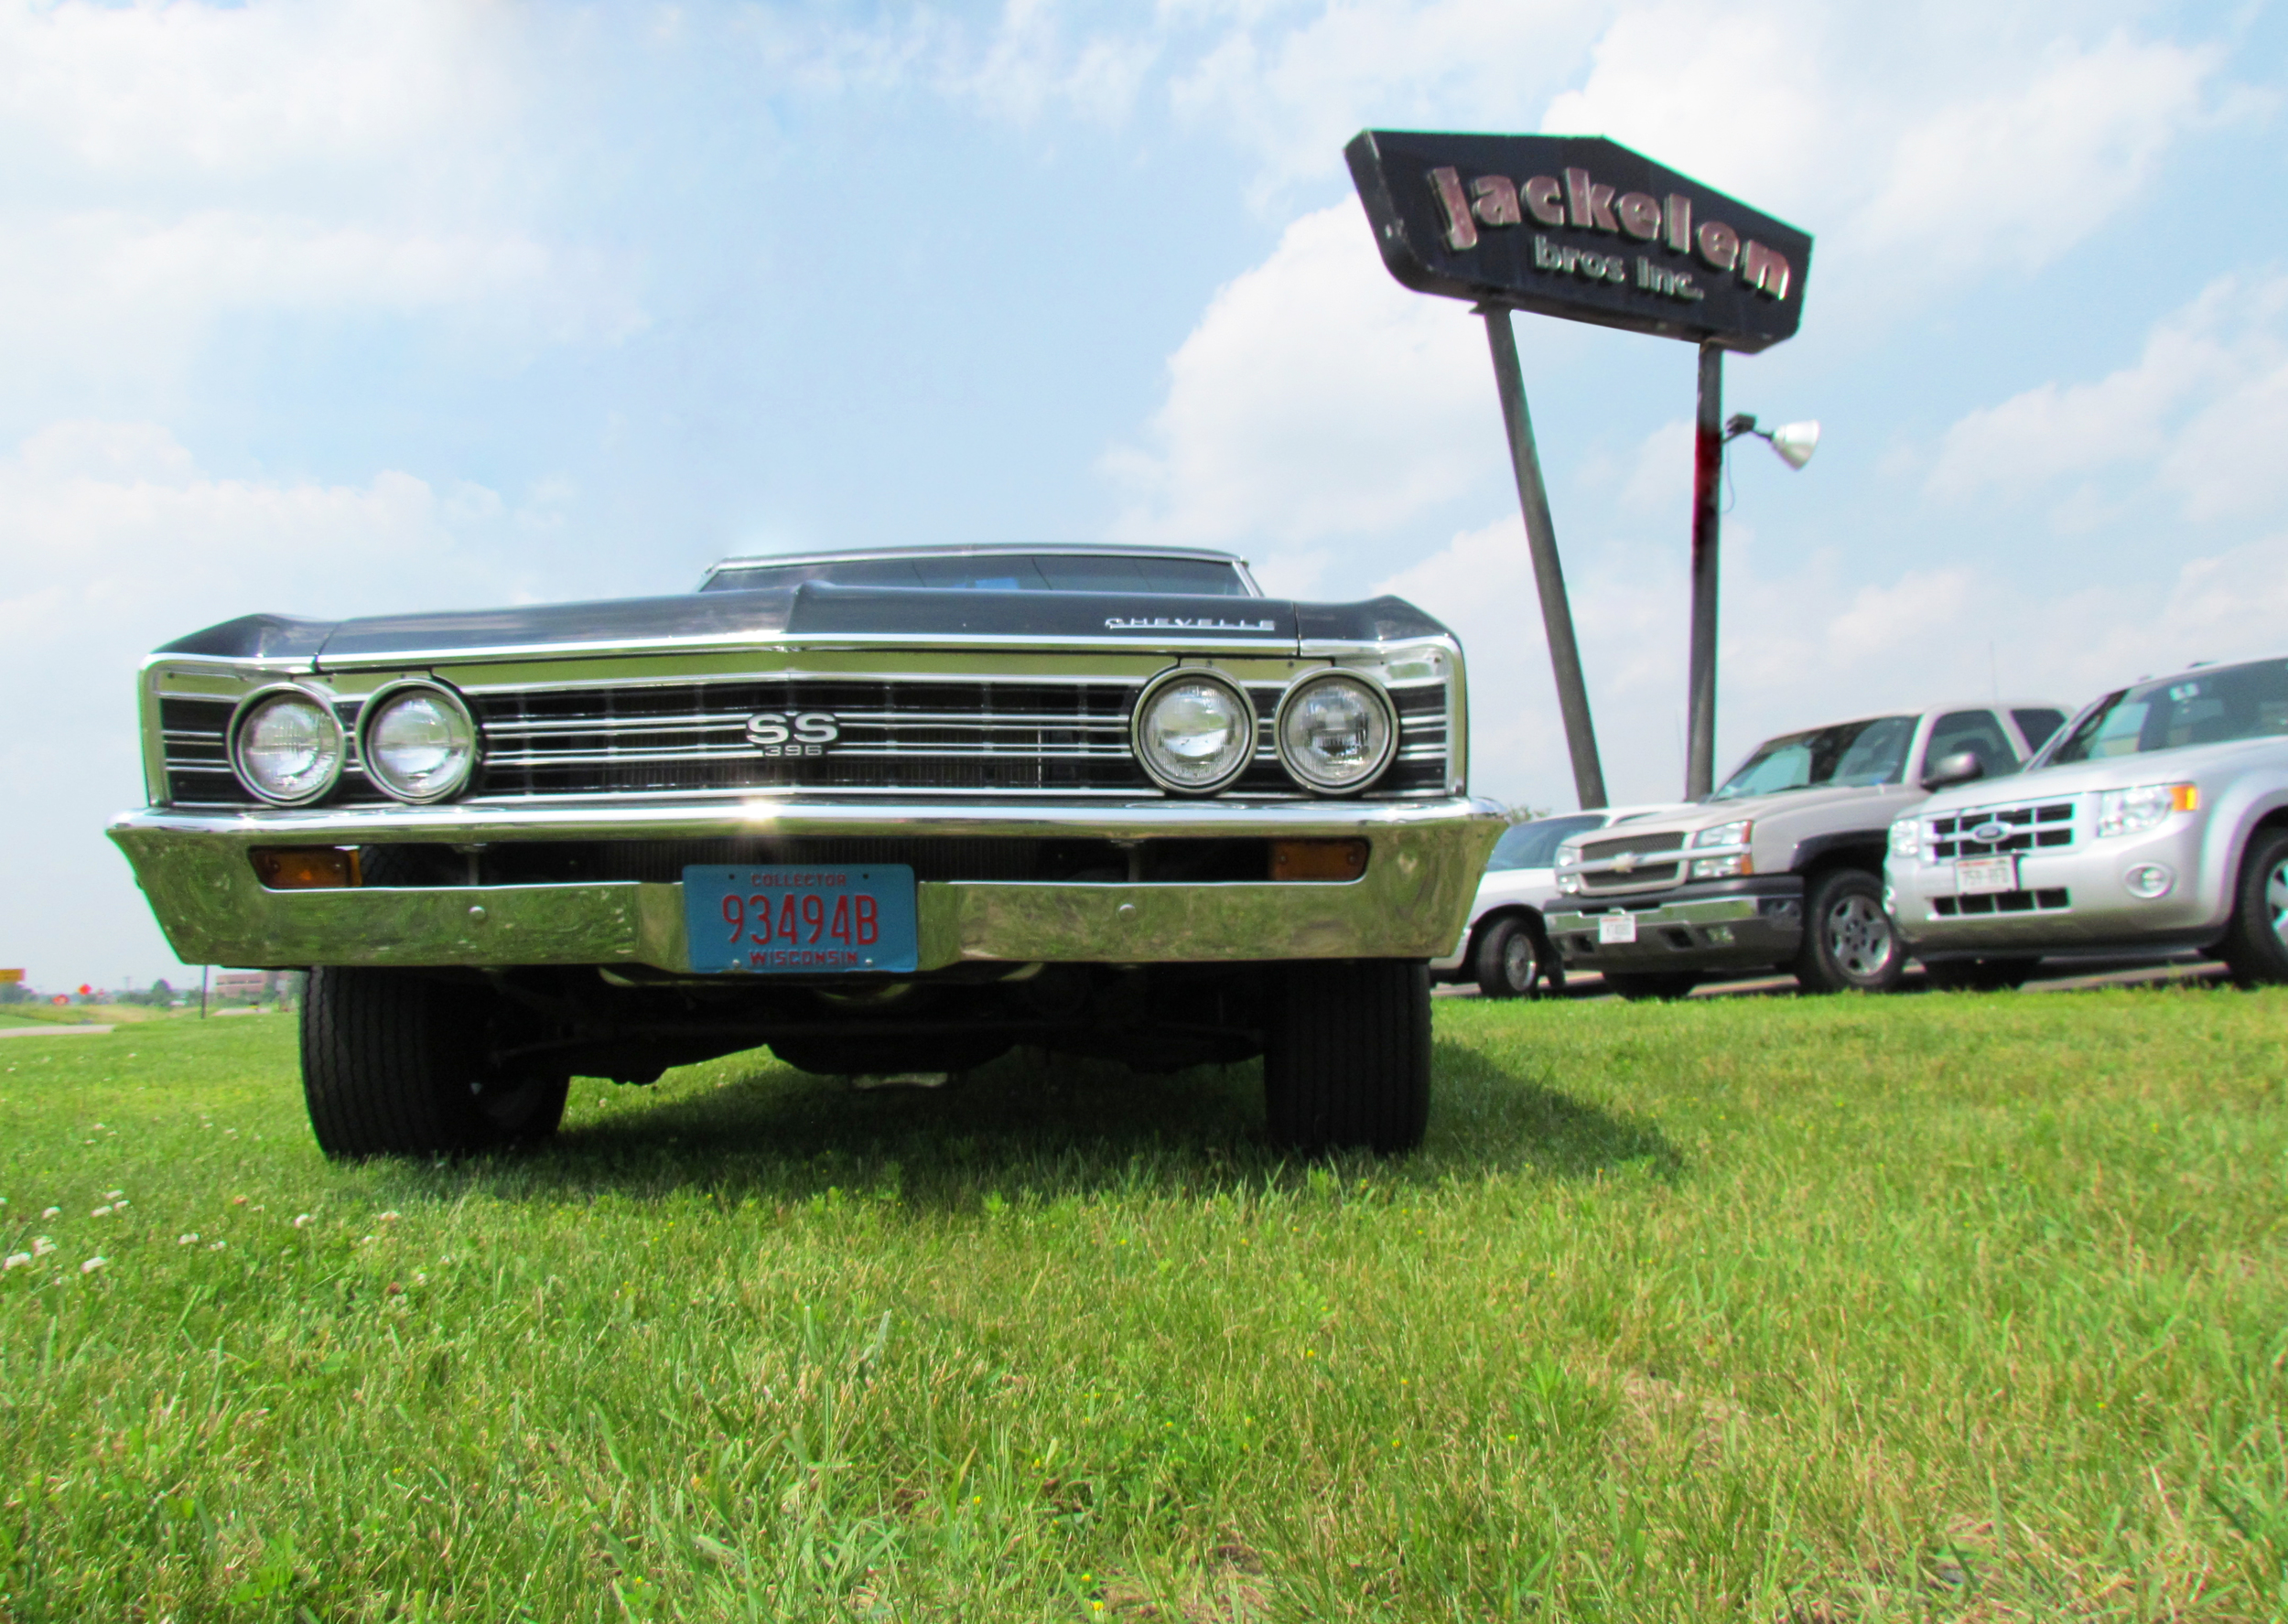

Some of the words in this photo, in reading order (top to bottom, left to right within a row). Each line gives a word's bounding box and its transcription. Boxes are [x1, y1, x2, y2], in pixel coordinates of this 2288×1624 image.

[1535, 234, 1625, 284] bros
[1105, 618, 1274, 630] CHEVELLE
[746, 713, 838, 745] SS
[764, 745, 822, 757] 396
[750, 872, 847, 887] COLLECTOR
[721, 893, 880, 946] 93494B
[749, 949, 858, 966] WISCONSIN
